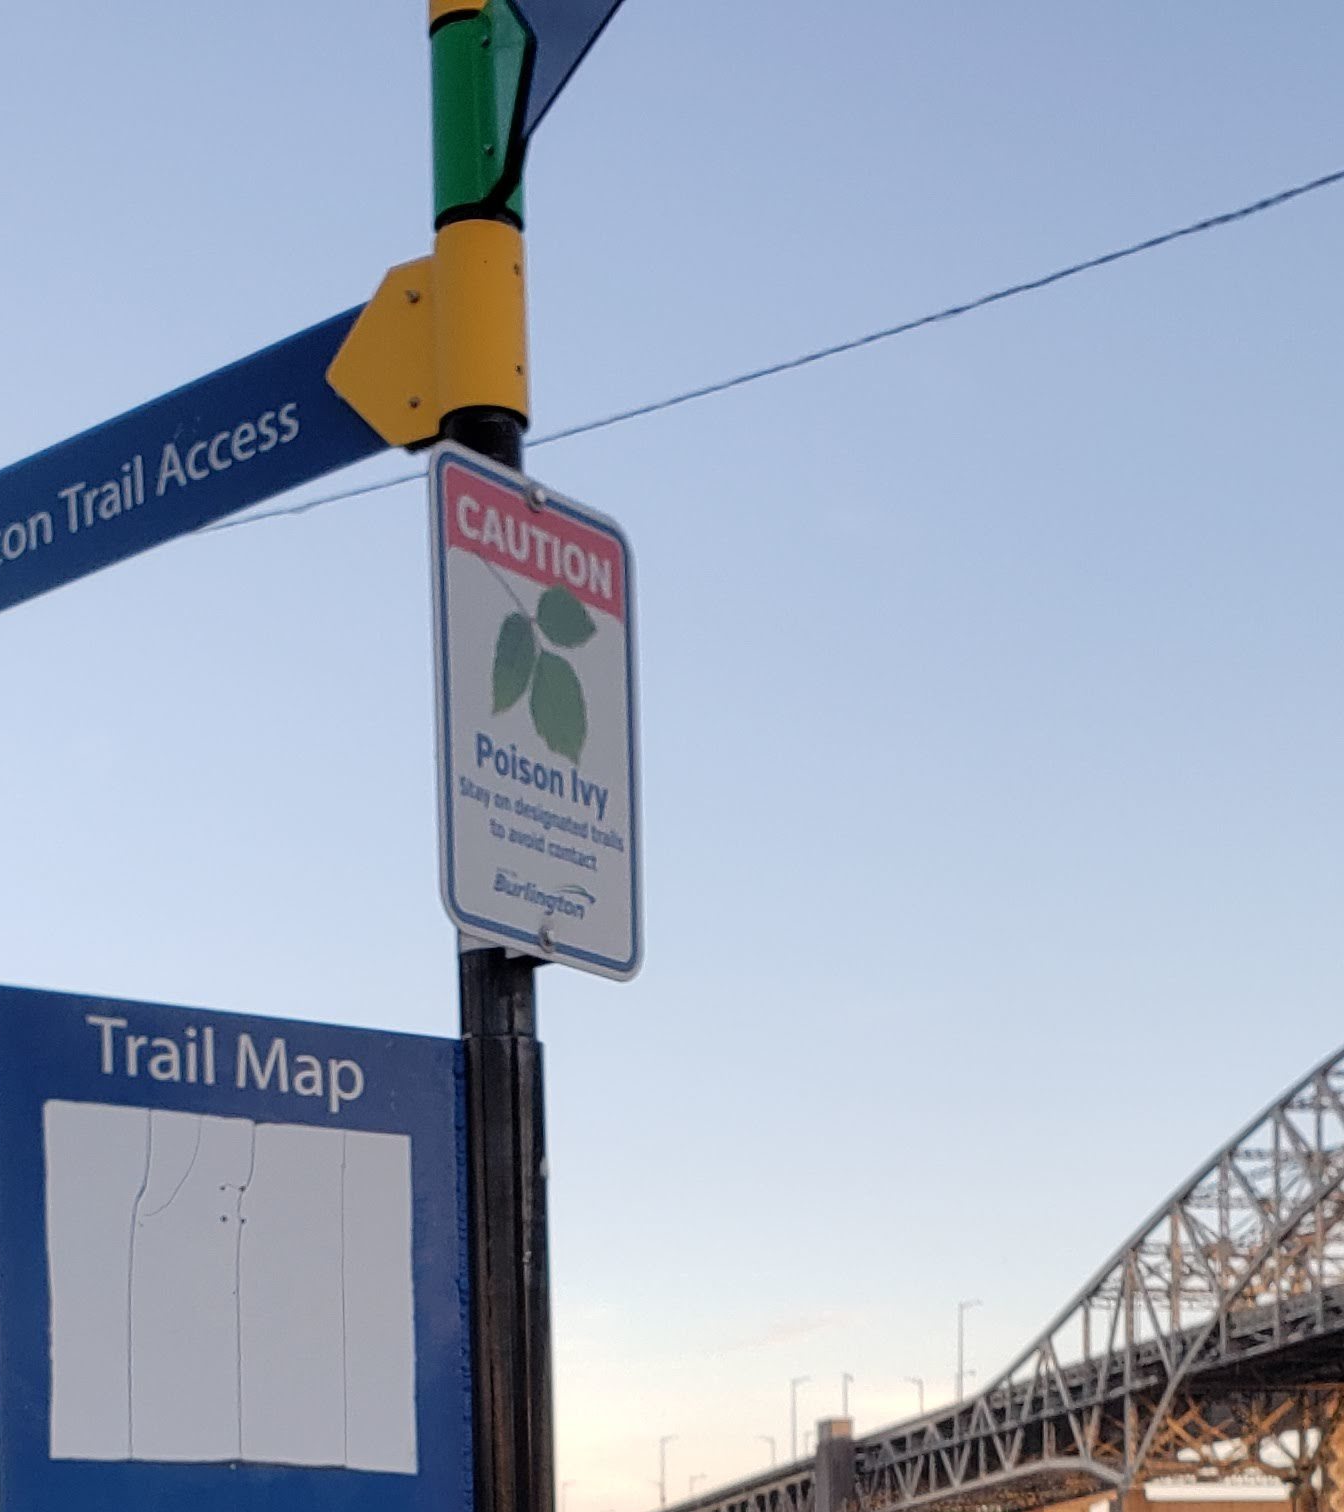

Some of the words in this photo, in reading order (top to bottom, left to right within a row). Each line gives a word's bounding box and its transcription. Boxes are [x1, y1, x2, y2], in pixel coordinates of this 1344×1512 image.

[57, 454, 145, 533] Trail
[156, 402, 300, 497] Access
[457, 495, 613, 599] CAUTION
[476, 732, 564, 798] Poison
[571, 767, 608, 821] Ivy
[493, 793, 512, 811] on
[514, 797, 588, 839] designated
[489, 818, 506, 838] to
[508, 828, 545, 853] avoid
[548, 843, 597, 871] contact
[494, 872, 584, 919] Burlington
[85, 1015, 216, 1086] Trail
[236, 1032, 365, 1114] Map
